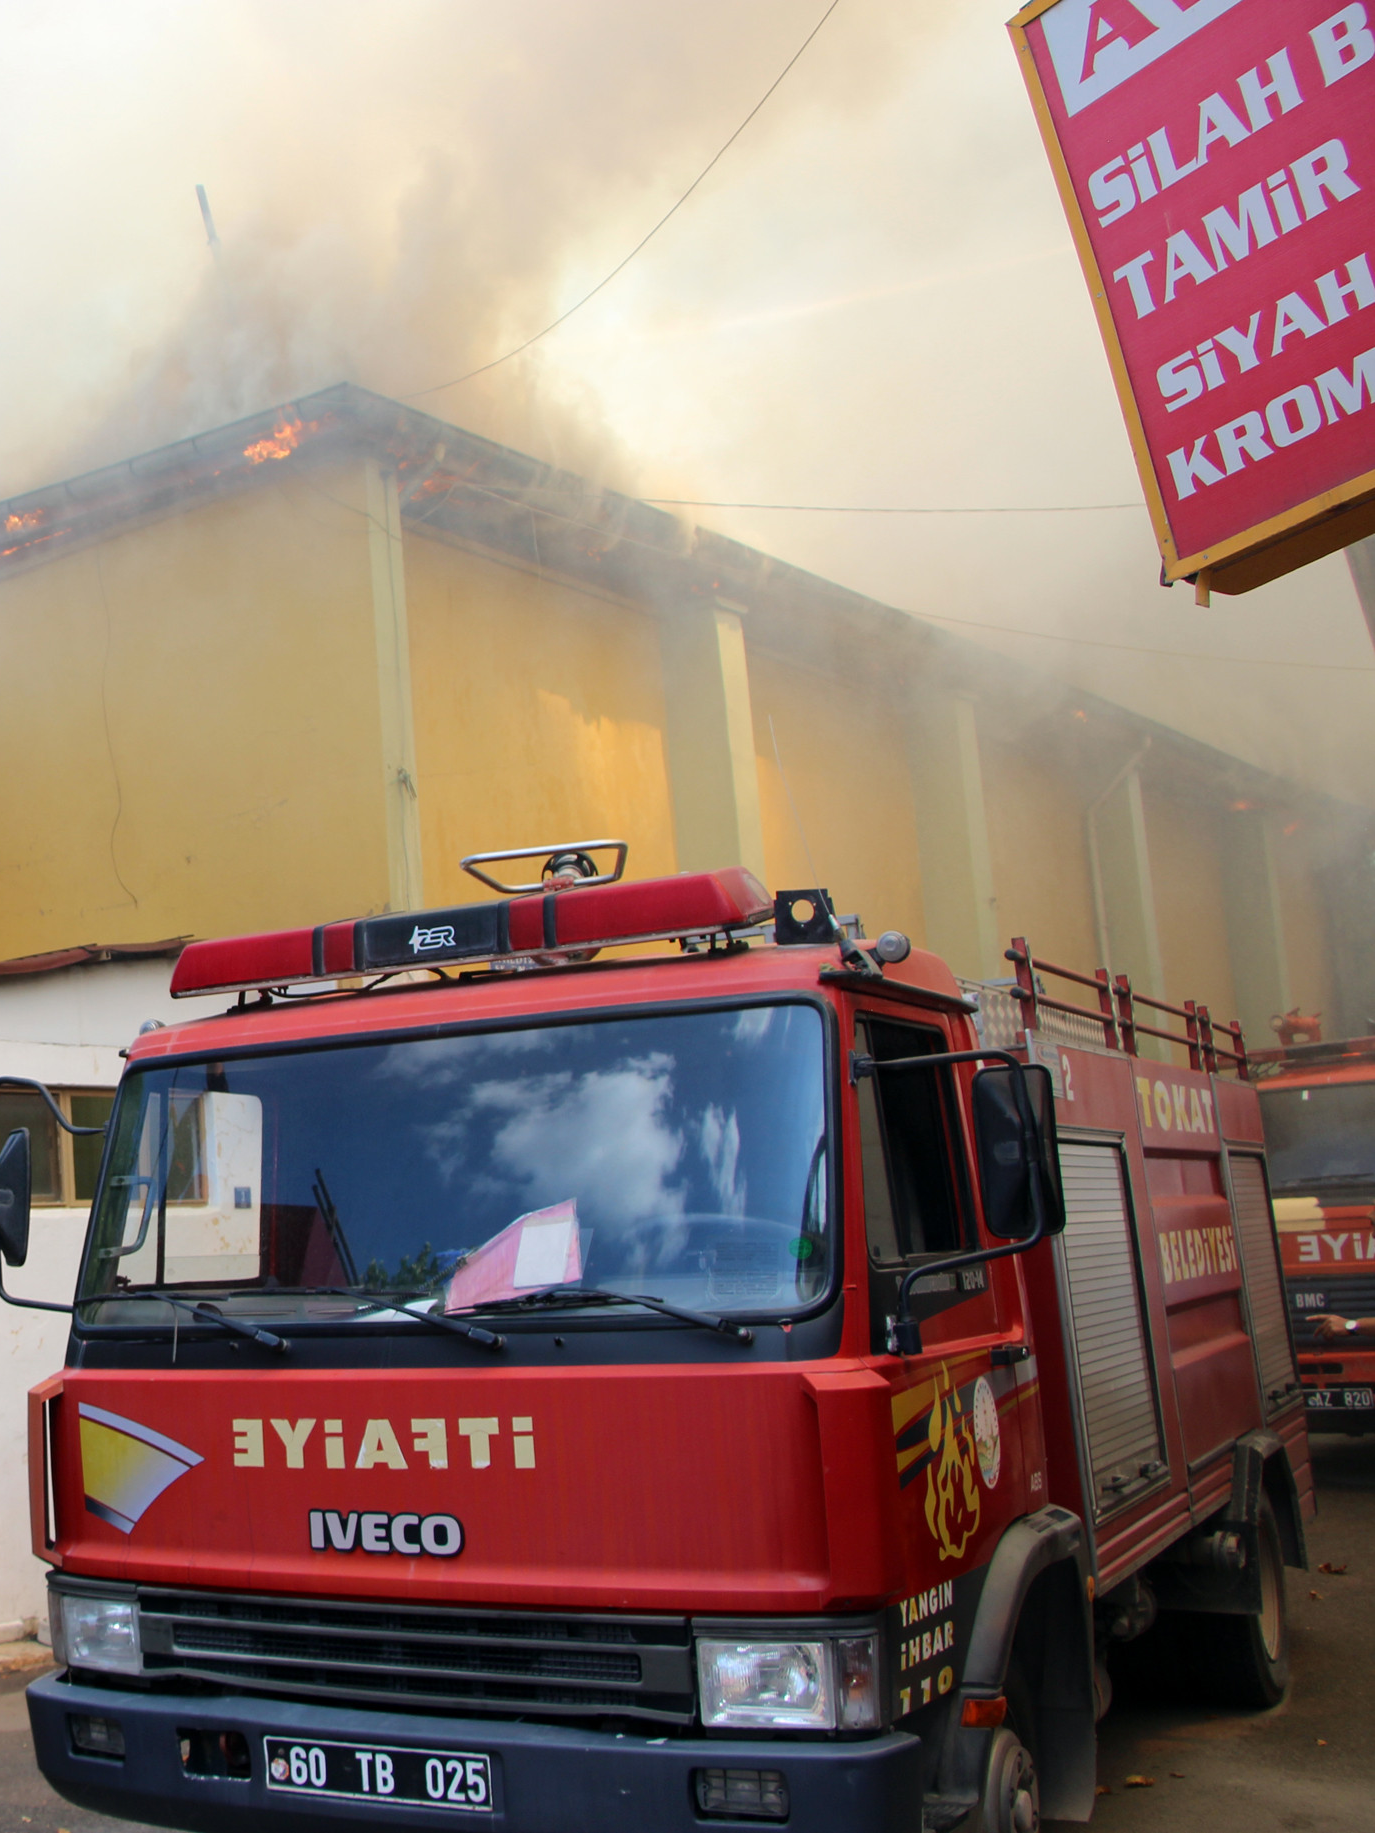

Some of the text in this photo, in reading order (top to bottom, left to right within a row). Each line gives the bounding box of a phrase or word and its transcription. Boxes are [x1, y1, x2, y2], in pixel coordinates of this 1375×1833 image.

[1136, 1076, 1214, 1134] TOKAT
[1159, 1225, 1238, 1284] BELEDİYESİ
[1296, 1293, 1325, 1308] BMC
[1344, 1391, 1371, 1407] 820
[309, 1510, 463, 1556] IVECO
[899, 1580, 953, 1628] YANGIN
[290, 1746, 487, 1803] 60 TB 025
